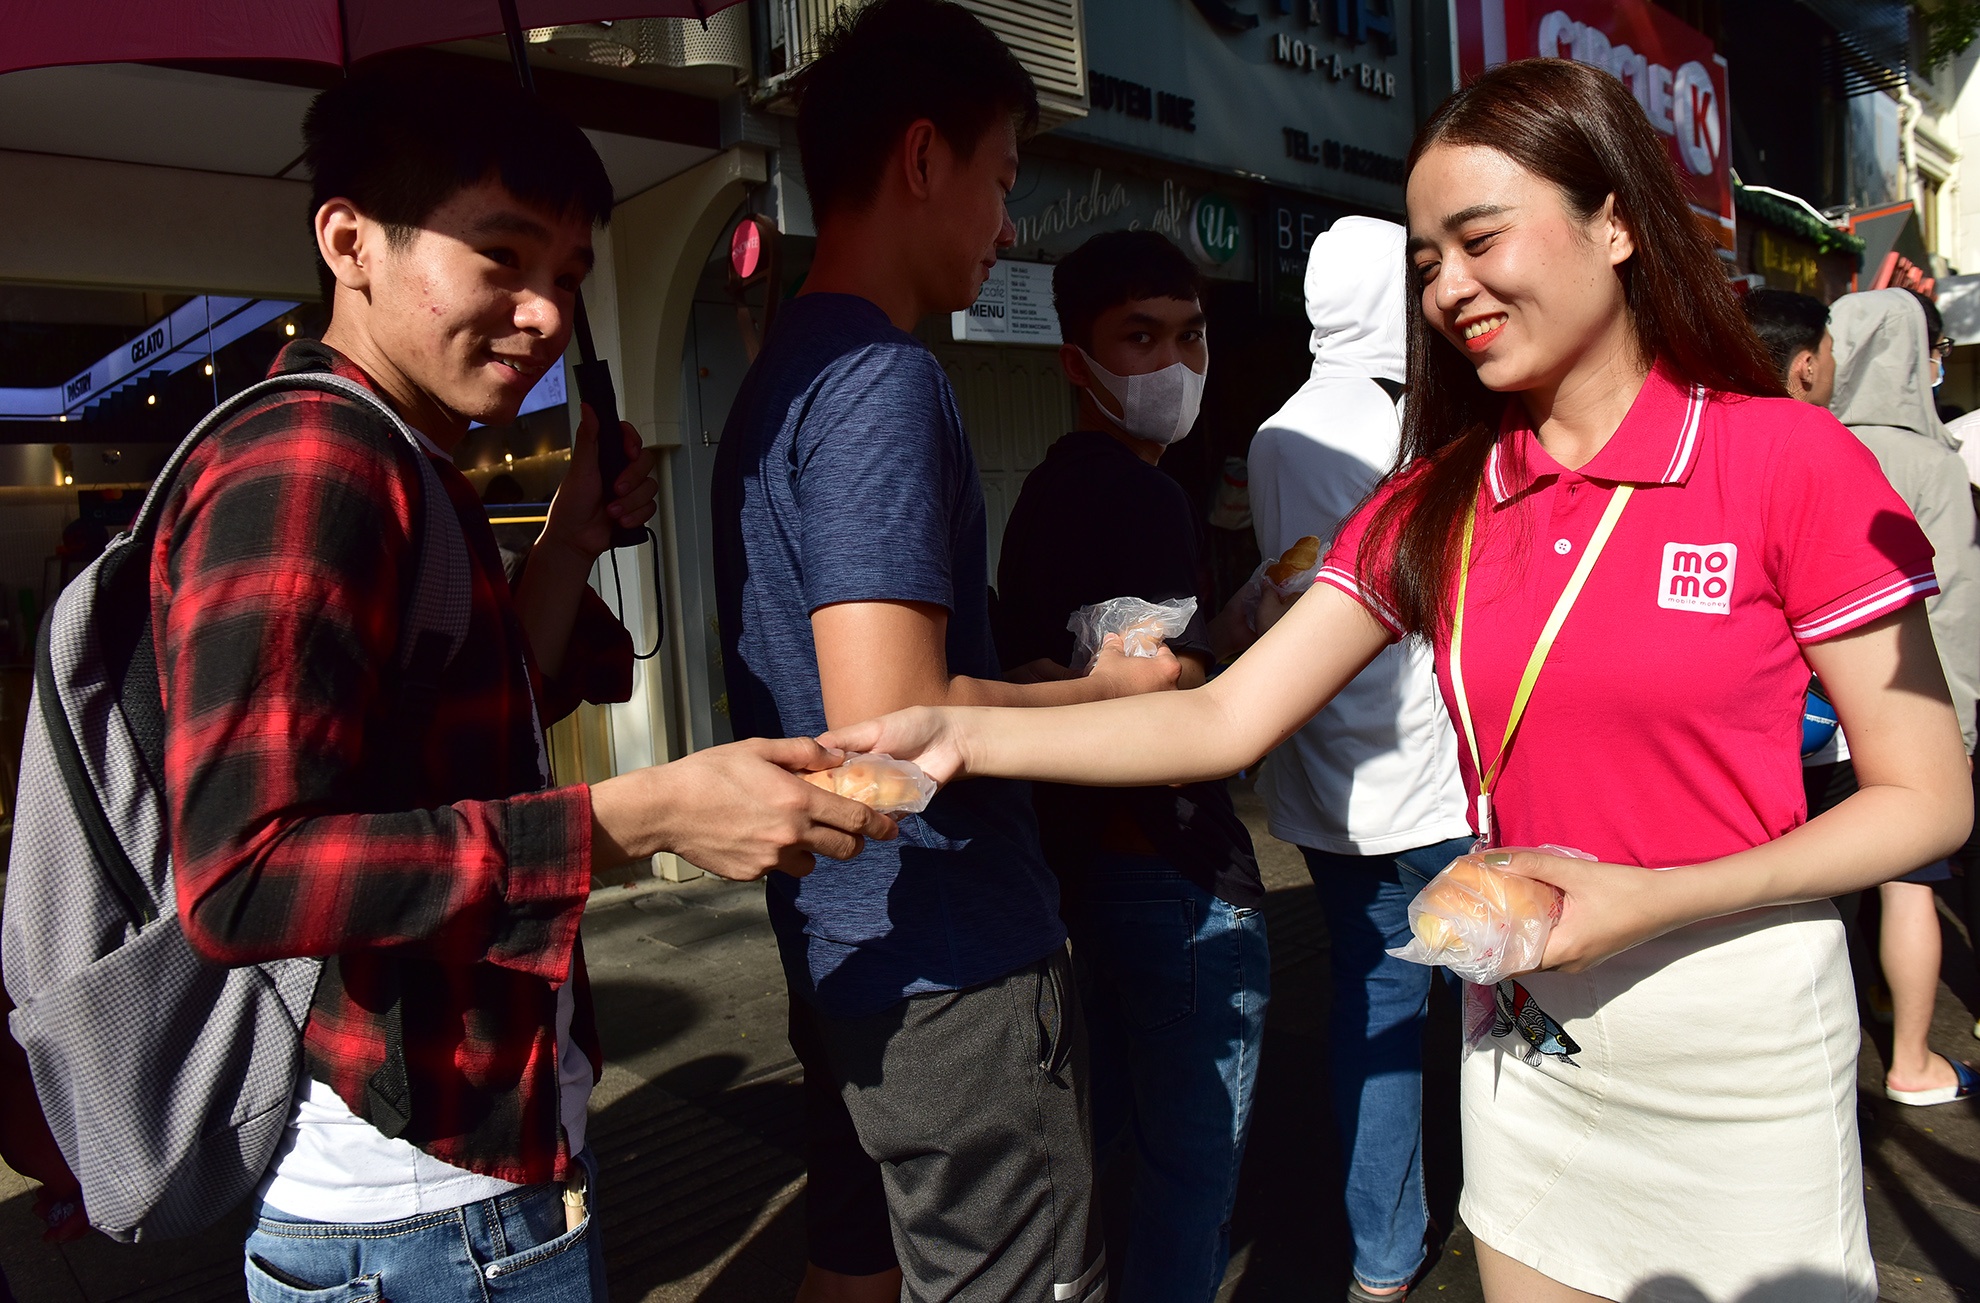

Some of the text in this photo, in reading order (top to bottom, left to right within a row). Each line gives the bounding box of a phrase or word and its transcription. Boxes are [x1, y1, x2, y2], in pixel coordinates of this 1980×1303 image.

[1277, 207, 1328, 253] BE
[969, 304, 1005, 319] MENU
[132, 328, 163, 363] GELATO
[67, 372, 91, 402] PASTRY
[1672, 551, 1728, 574] mo
[1669, 575, 1727, 598] mo
[1668, 597, 1696, 605] mobile
